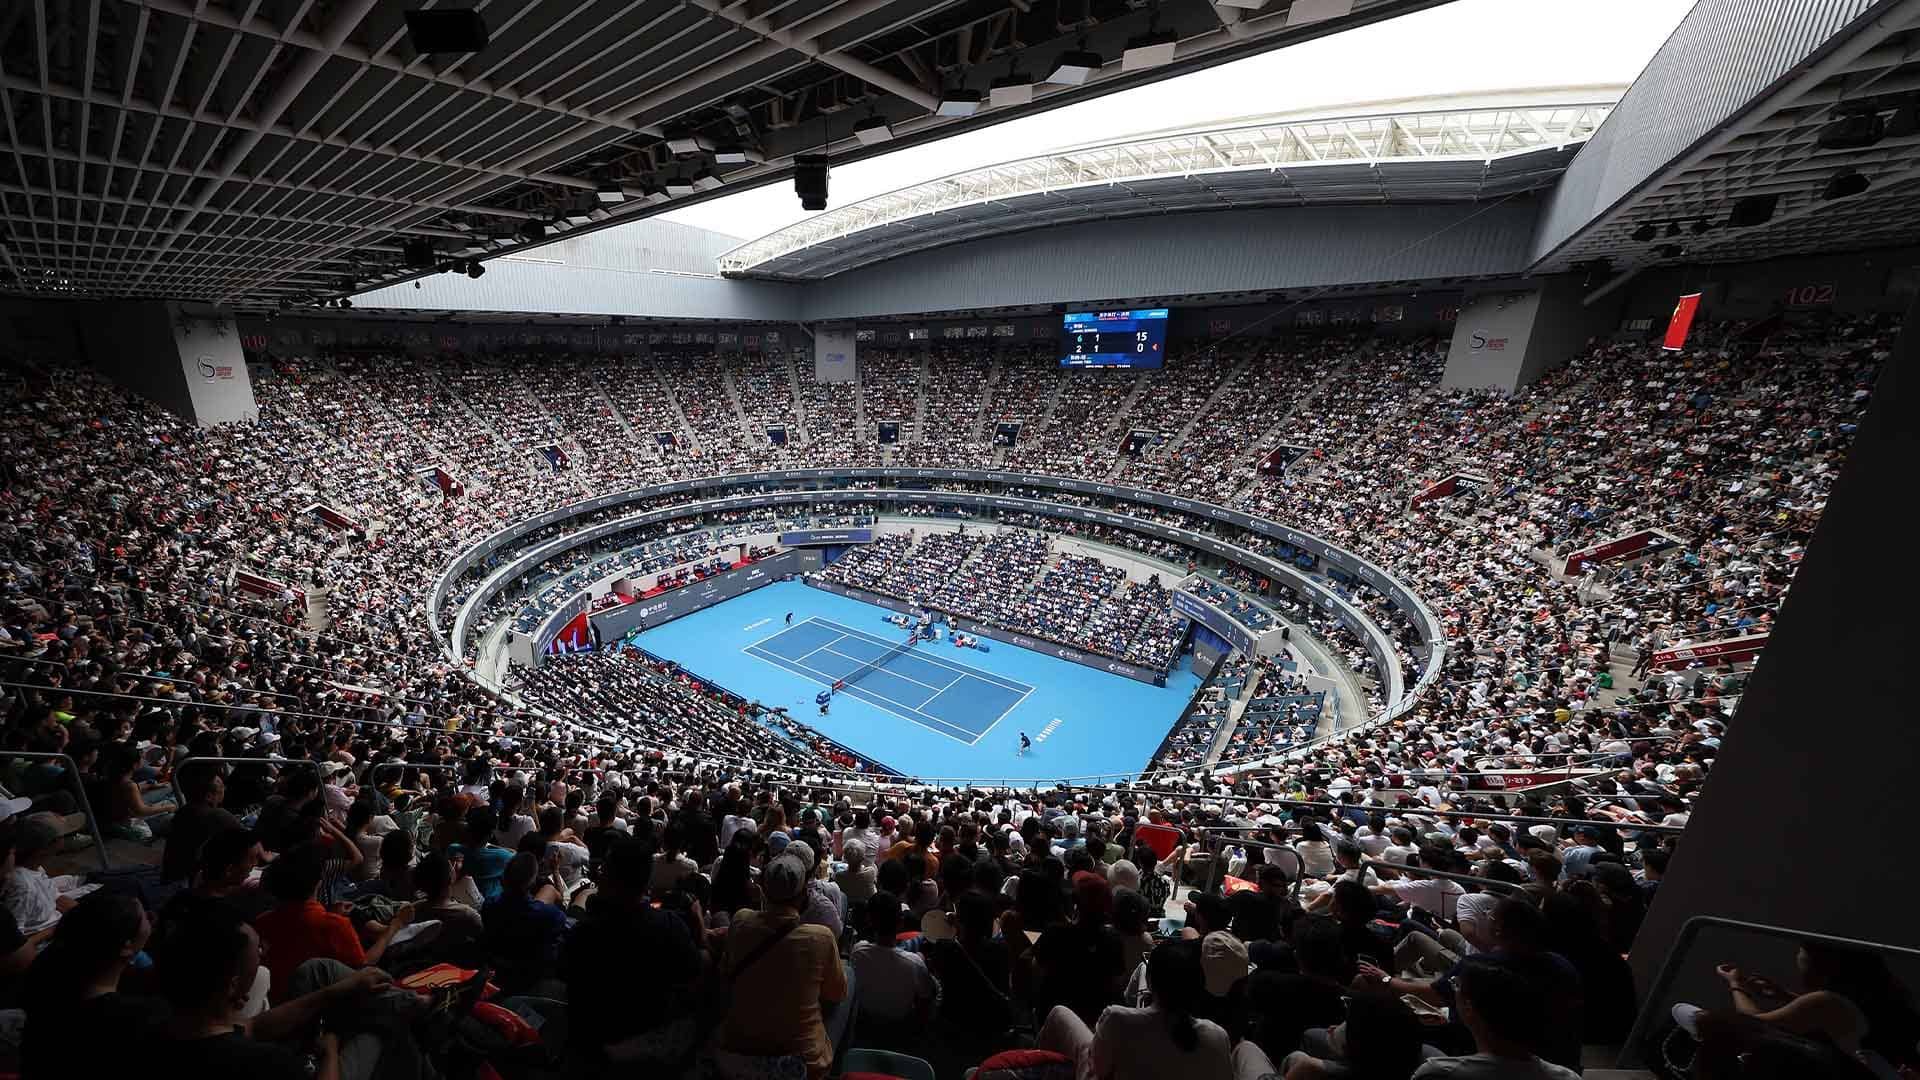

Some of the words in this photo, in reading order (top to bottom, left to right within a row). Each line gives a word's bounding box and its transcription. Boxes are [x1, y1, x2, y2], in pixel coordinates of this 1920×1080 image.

[1786, 285, 1832, 304] 102
[1095, 334, 1100, 342] 1
[1136, 331, 1148, 341] 15
[1137, 343, 1144, 352] 0
